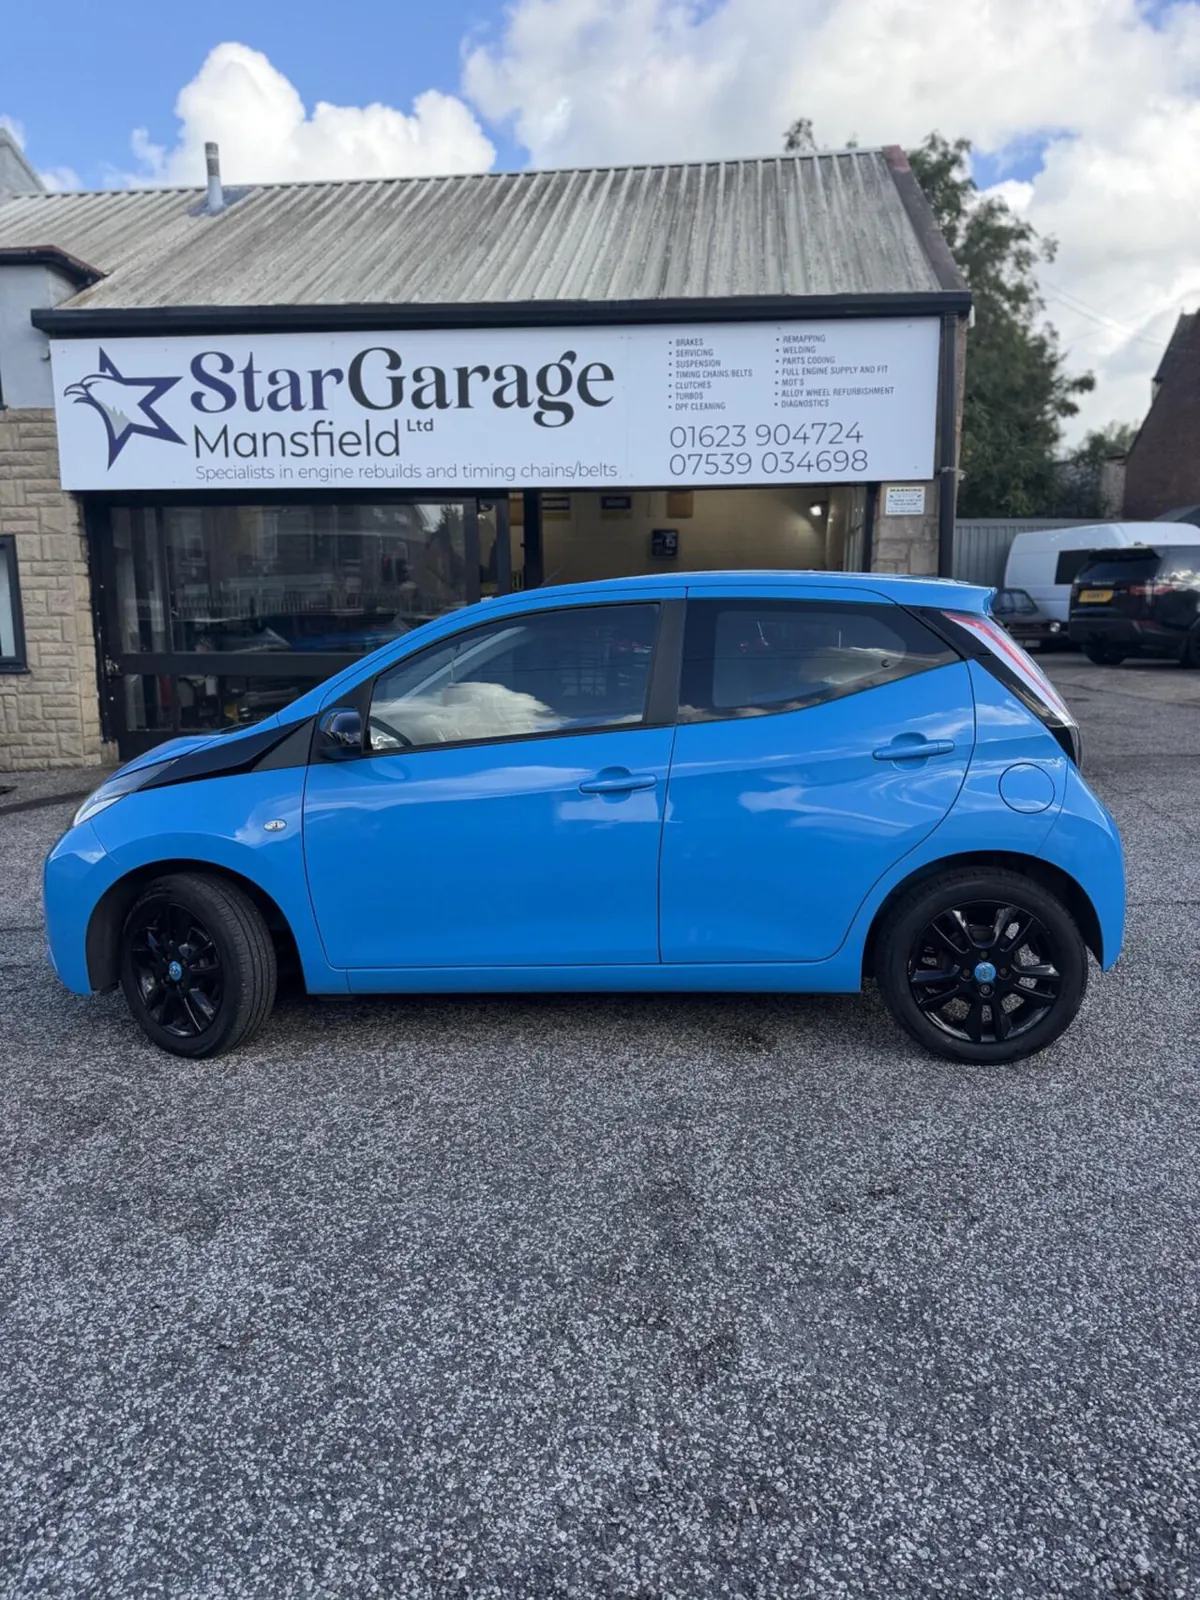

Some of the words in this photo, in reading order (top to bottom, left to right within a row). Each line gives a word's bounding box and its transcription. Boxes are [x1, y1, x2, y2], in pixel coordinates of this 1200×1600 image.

[675, 338, 704, 347] BRAKES
[782, 334, 826, 344] REMAPPING
[675, 348, 714, 358] SERVICING
[782, 345, 816, 354] WELDING
[675, 359, 721, 368] SUSPENSION
[782, 356, 806, 365] PARTS
[807, 355, 836, 364] CODING
[675, 370, 701, 379] TIMING
[781, 368, 800, 377] FULL
[802, 366, 829, 375] ENGINE
[830, 366, 858, 375] SUPPLY
[860, 365, 876, 374] AND
[877, 365, 889, 374] FIT
[675, 381, 712, 390] CLUTCHES
[675, 391, 704, 401] TURBOS
[781, 388, 804, 398] ALLOY
[806, 388, 831, 397] WHEEL
[833, 386, 895, 396] REFURBISHMENT
[675, 403, 689, 411] DPF
[691, 402, 726, 411] CLEANING
[781, 399, 829, 409] DIAGNOSTICS
[193, 419, 400, 459] Mansfield
[406, 418, 434, 432] Ltd
[669, 424, 747, 449] 01623
[754, 421, 864, 446] 904724
[669, 453, 752, 476] 07539
[760, 449, 869, 474] 034698
[195, 465, 275, 482] Specialists
[279, 464, 294, 479] in
[298, 466, 354, 482] engine
[358, 463, 422, 479] rebuilds
[426, 463, 457, 478] and
[462, 463, 516, 481] timing
[520, 460, 618, 479] chains/belts
